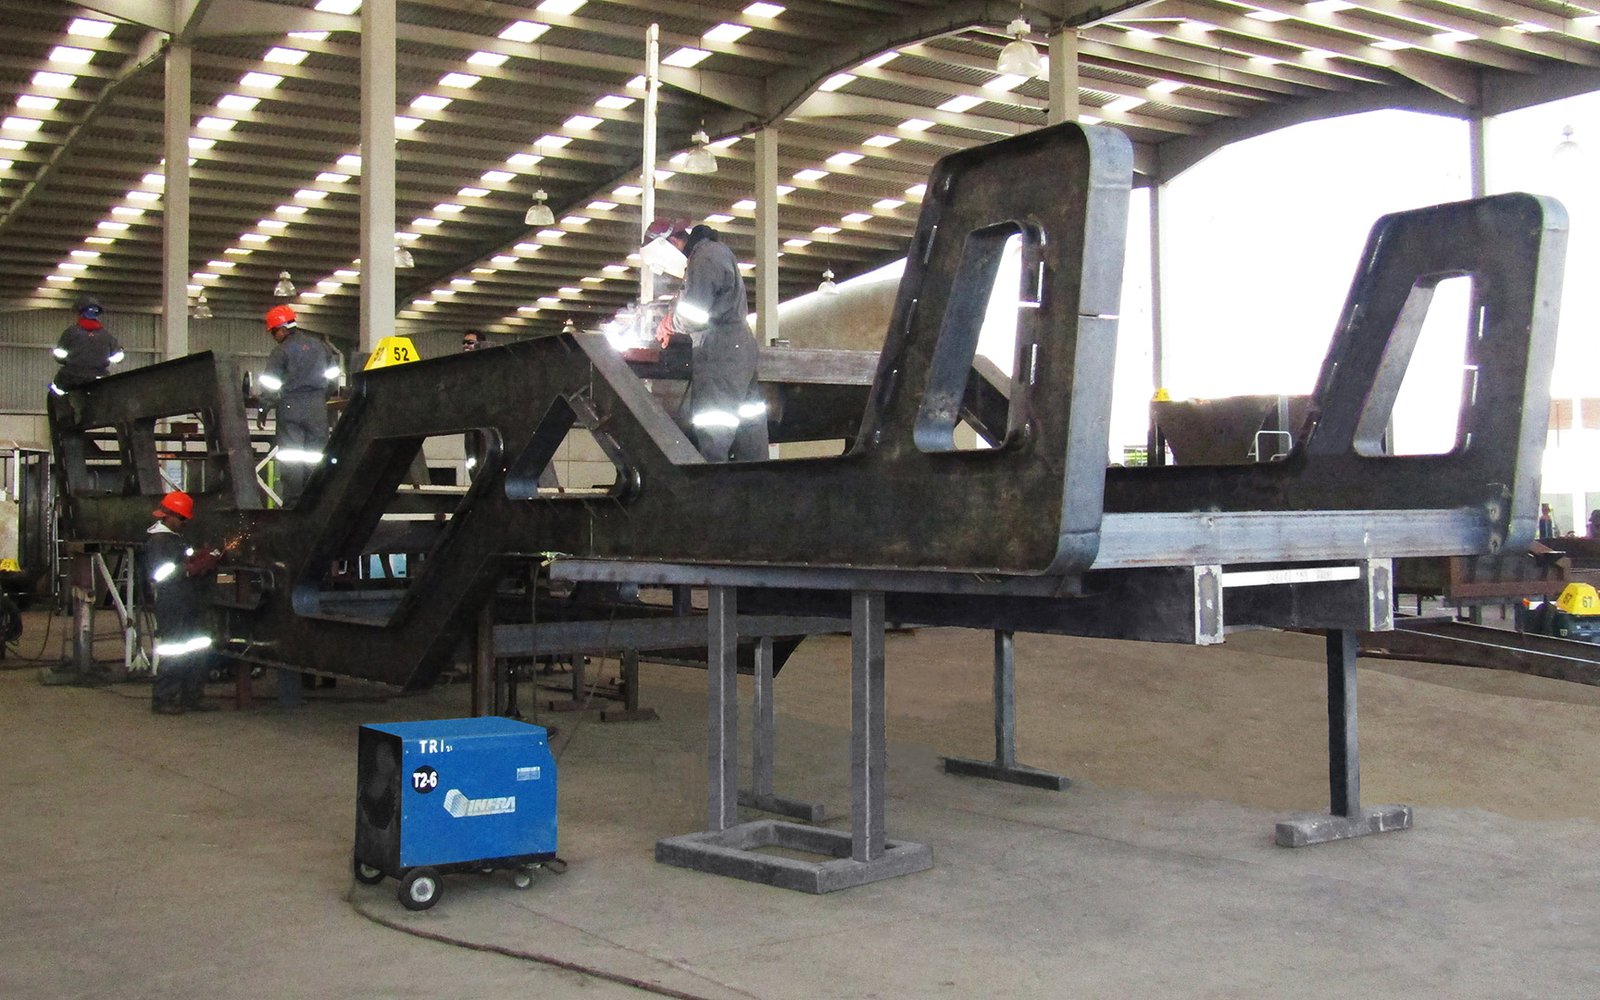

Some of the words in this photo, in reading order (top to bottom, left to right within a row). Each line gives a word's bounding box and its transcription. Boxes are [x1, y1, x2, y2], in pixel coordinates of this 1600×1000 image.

[394, 346, 410, 361] 52
[413, 771, 437, 788] T2-6
[467, 797, 515, 813] INFRA
